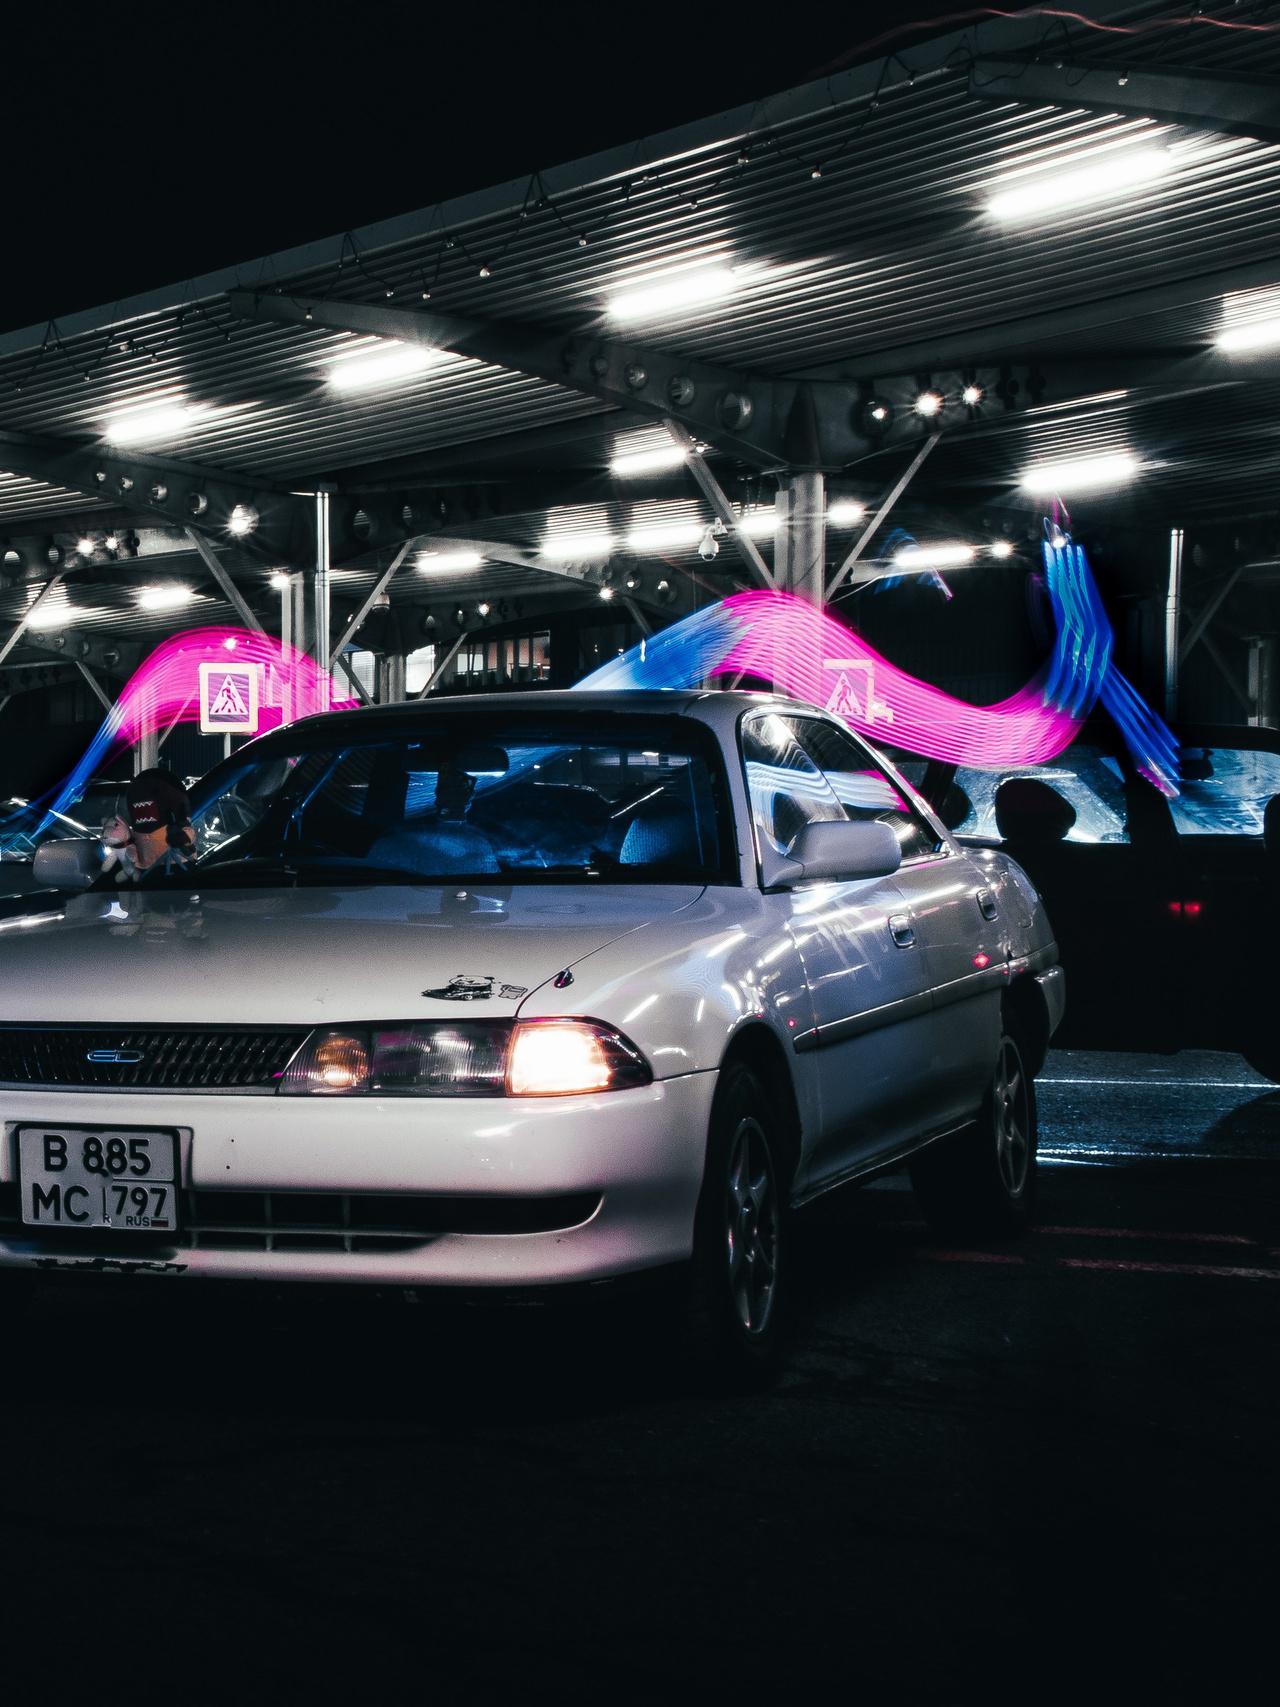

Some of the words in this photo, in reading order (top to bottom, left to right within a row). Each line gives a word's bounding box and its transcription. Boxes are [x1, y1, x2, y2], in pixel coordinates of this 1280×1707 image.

[43, 1134, 68, 1172] B
[82, 1136, 151, 1176] 885
[32, 1182, 90, 1222] MC
[111, 1185, 167, 1217] 797
[125, 1216, 150, 1227] RUS
